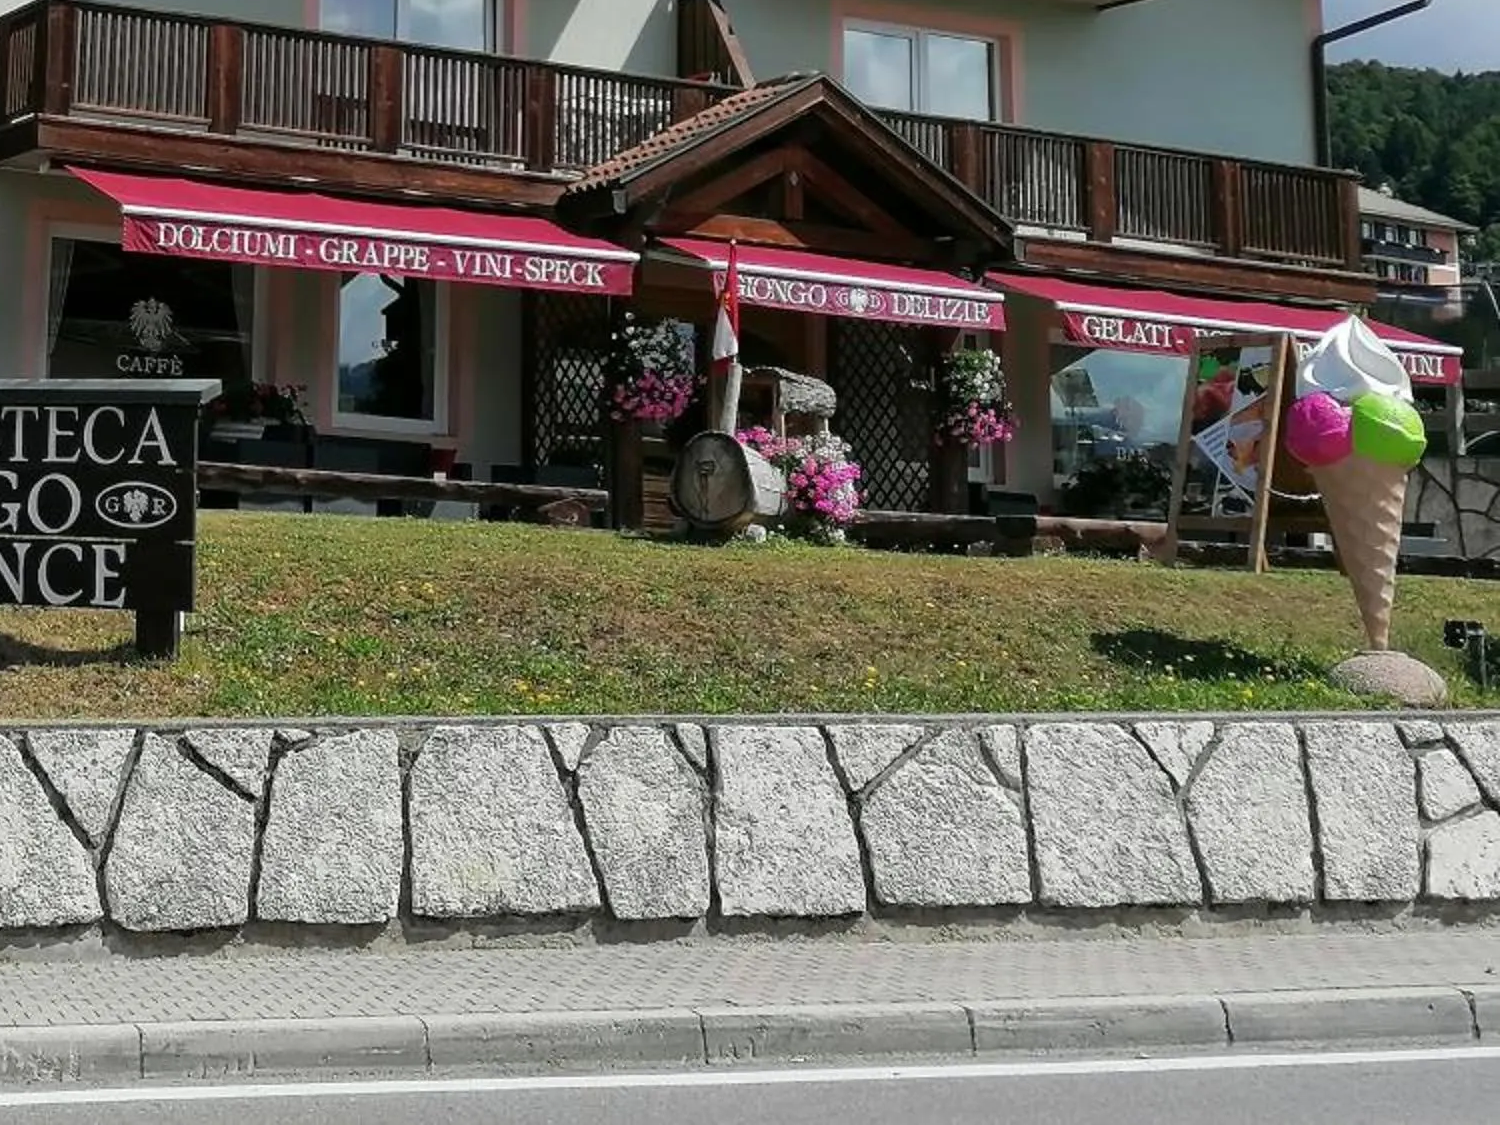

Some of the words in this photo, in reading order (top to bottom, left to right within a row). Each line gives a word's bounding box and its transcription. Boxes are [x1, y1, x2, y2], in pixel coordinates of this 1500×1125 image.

[157, 222, 298, 259] DOLCIUMI
[319, 238, 431, 272] GRAPPE
[891, 292, 993, 324] DELIZIE
[116, 354, 183, 375] CAFFÈ
[105, 496, 120, 514] G
[151, 497, 167, 516] R
